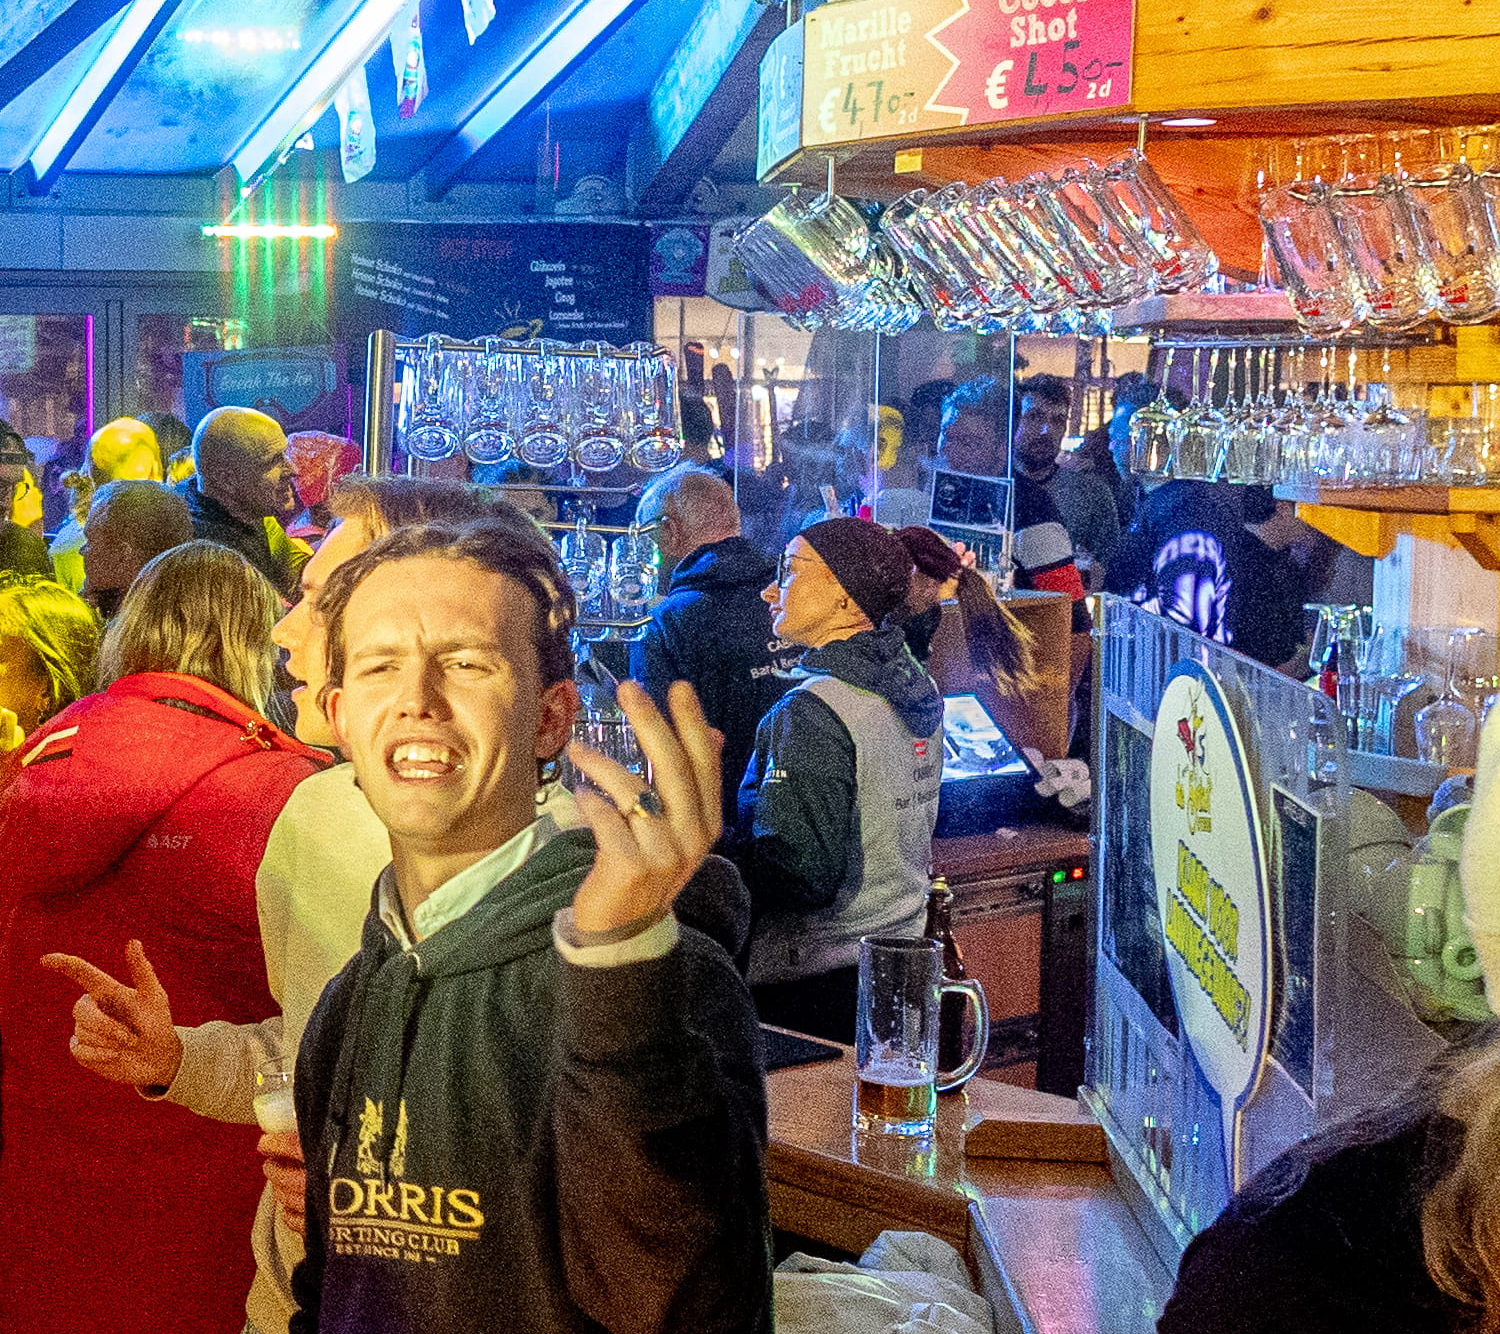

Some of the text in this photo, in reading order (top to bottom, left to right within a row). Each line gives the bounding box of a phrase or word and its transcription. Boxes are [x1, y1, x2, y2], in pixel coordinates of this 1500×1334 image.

[819, 5, 913, 51] Marille
[1009, 7, 1080, 49] Shot
[823, 41, 907, 80] Frucht
[984, 59, 1015, 110] €
[818, 86, 842, 135] €
[328, 1176, 486, 1230] ORRIS
[407, 1233, 461, 1256] CLUB
